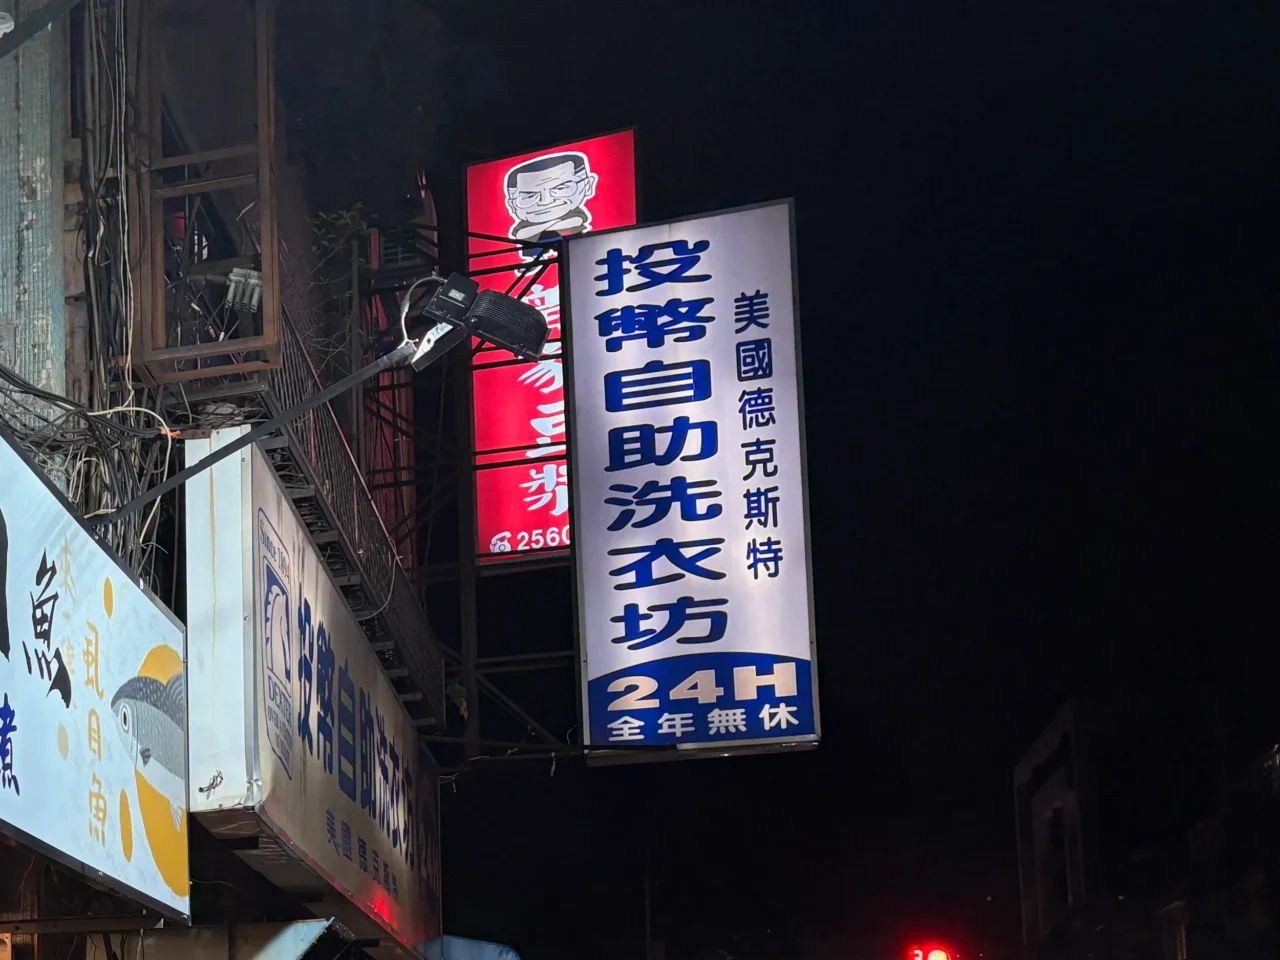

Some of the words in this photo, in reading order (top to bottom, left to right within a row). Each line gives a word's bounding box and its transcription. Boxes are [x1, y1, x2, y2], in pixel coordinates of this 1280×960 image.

[593, 238, 730, 652] 投幣自助洗衣坊
[733, 288, 784, 581] 美國德克斯特
[297, 580, 415, 872] 投幣自助洗衣坊
[606, 703, 800, 743] 全年無休
[607, 660, 798, 713] 24H
